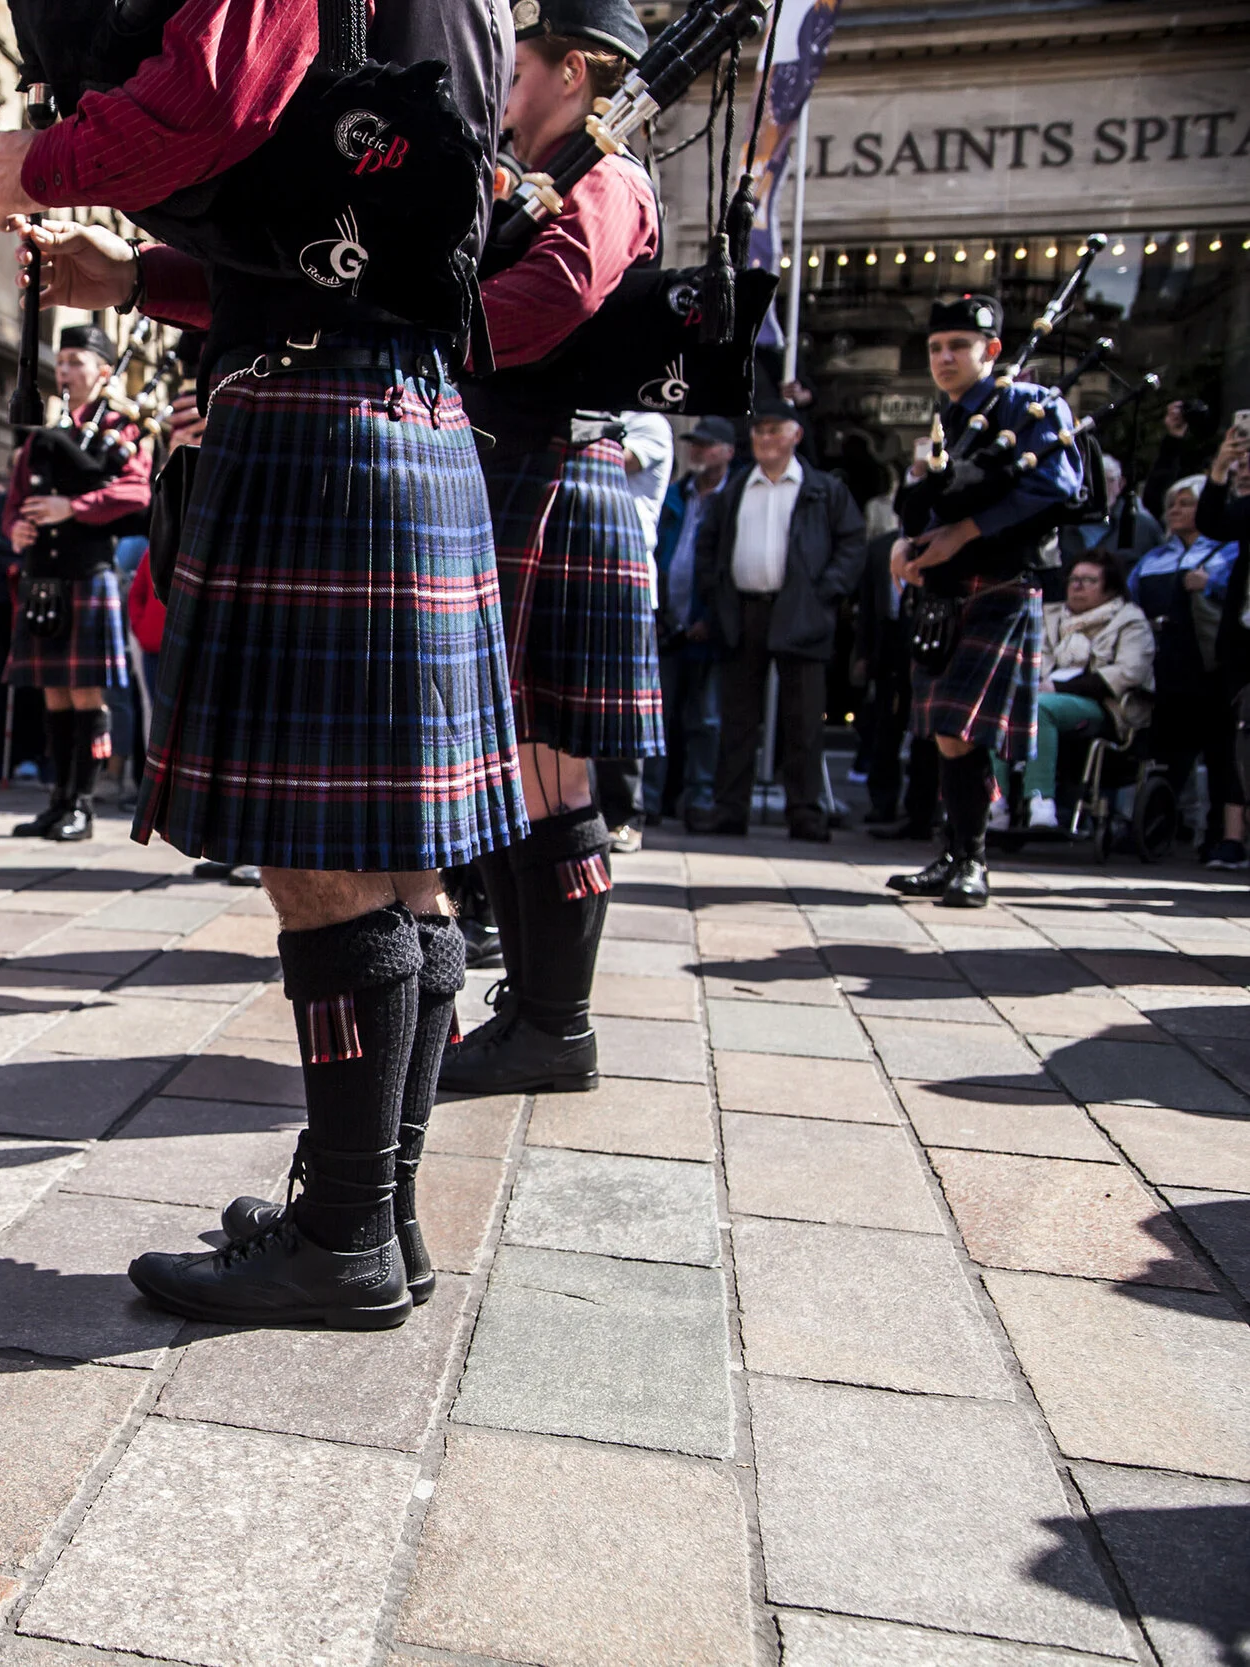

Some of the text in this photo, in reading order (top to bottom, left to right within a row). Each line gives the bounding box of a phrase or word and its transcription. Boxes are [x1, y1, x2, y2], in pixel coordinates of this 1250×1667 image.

[333, 108, 391, 161] Celtic
[783, 119, 1074, 180] LSAINTS
[306, 263, 341, 285] Reeds
